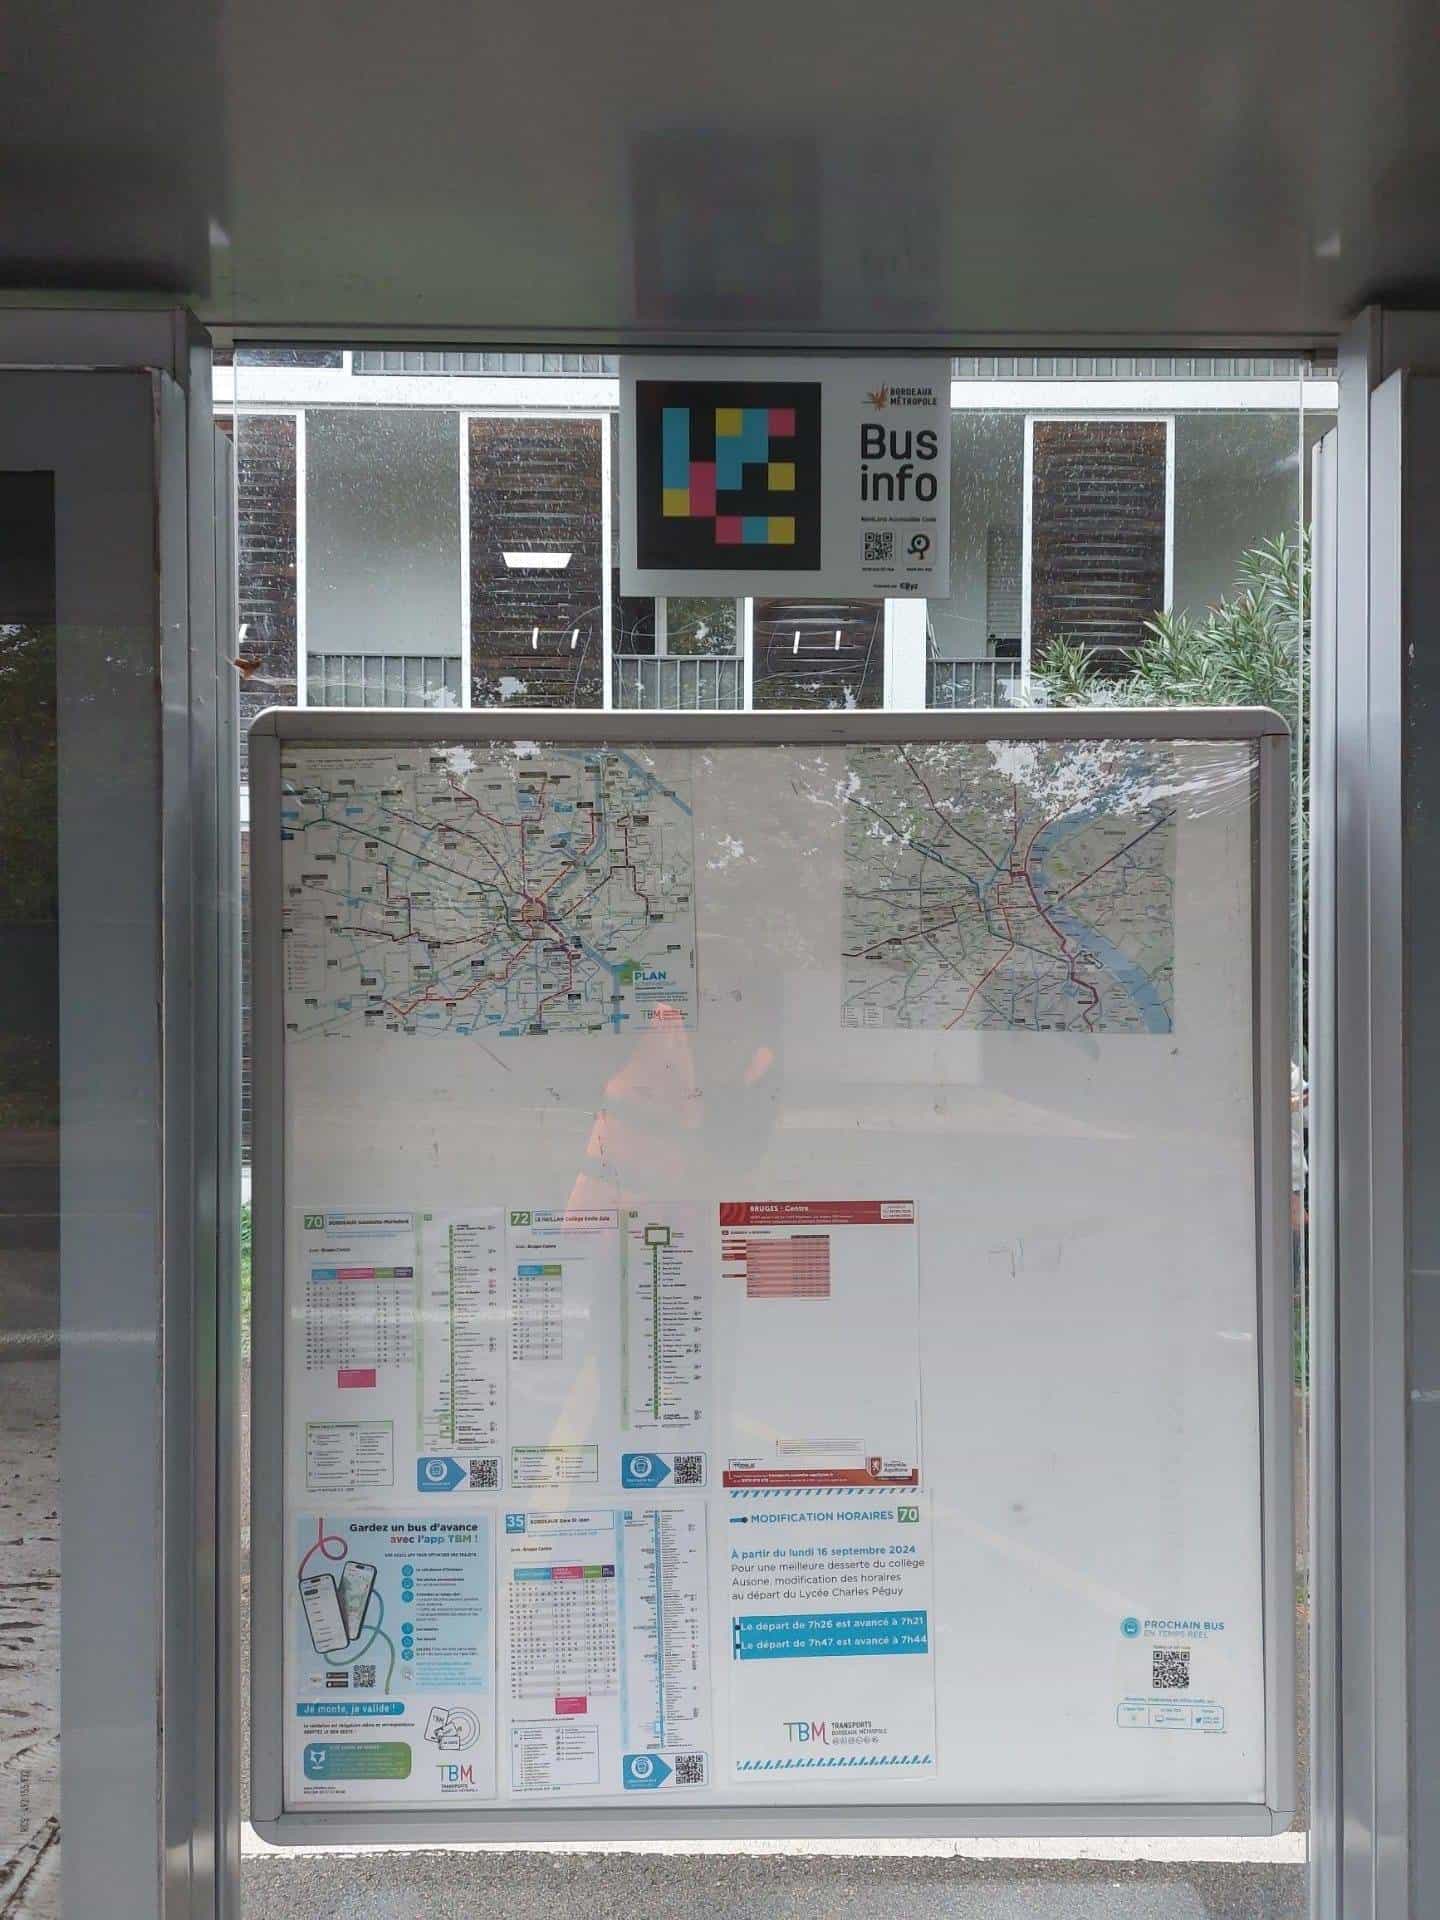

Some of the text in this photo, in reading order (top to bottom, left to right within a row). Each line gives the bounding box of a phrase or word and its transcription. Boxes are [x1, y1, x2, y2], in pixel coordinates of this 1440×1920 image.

[861, 423, 938, 460] Bus
[861, 463, 938, 502] info
[634, 971, 667, 981] PLAN
[305, 1216, 323, 1229] 70
[511, 1212, 529, 1225] 72
[506, 1514, 525, 1527] 35
[751, 1508, 918, 1523] MODIFICATION HORAIRES 70
[349, 1522, 478, 1532] Gardez un bus d'avance
[390, 1535, 415, 1544] avec
[447, 1534, 472, 1544] TBM
[742, 1549, 770, 1560] partir
[773, 1549, 786, 1558] du
[789, 1548, 815, 1557] lundi
[818, 1547, 828, 1556] 16
[831, 1546, 886, 1557] septembre
[889, 1545, 916, 1554] 2024
[731, 1564, 754, 1573] Pour
[758, 1564, 776, 1572] une
[780, 1561, 825, 1571] meilleure
[827, 1560, 870, 1570] desserte
[873, 1560, 886, 1568] du
[775, 1574, 838, 1585] modification
[840, 1574, 858, 1583] des
[861, 1572, 902, 1582] horaires
[731, 1586, 904, 1601] au départ du Lycée Charles Péguy
[740, 1616, 924, 1632] Le départ de 7h26 est avancé à 7h21
[1144, 1620, 1225, 1630] PROCHAIN BUS
[740, 1634, 928, 1650] Le départ de 7h47 est avancé à 7h44
[304, 1704, 315, 1713] Je
[351, 1704, 360, 1715] je
[362, 1703, 390, 1713] valide
[783, 1721, 872, 1745] TBM TRANSPORTS
[435, 1764, 476, 1785] TBM
